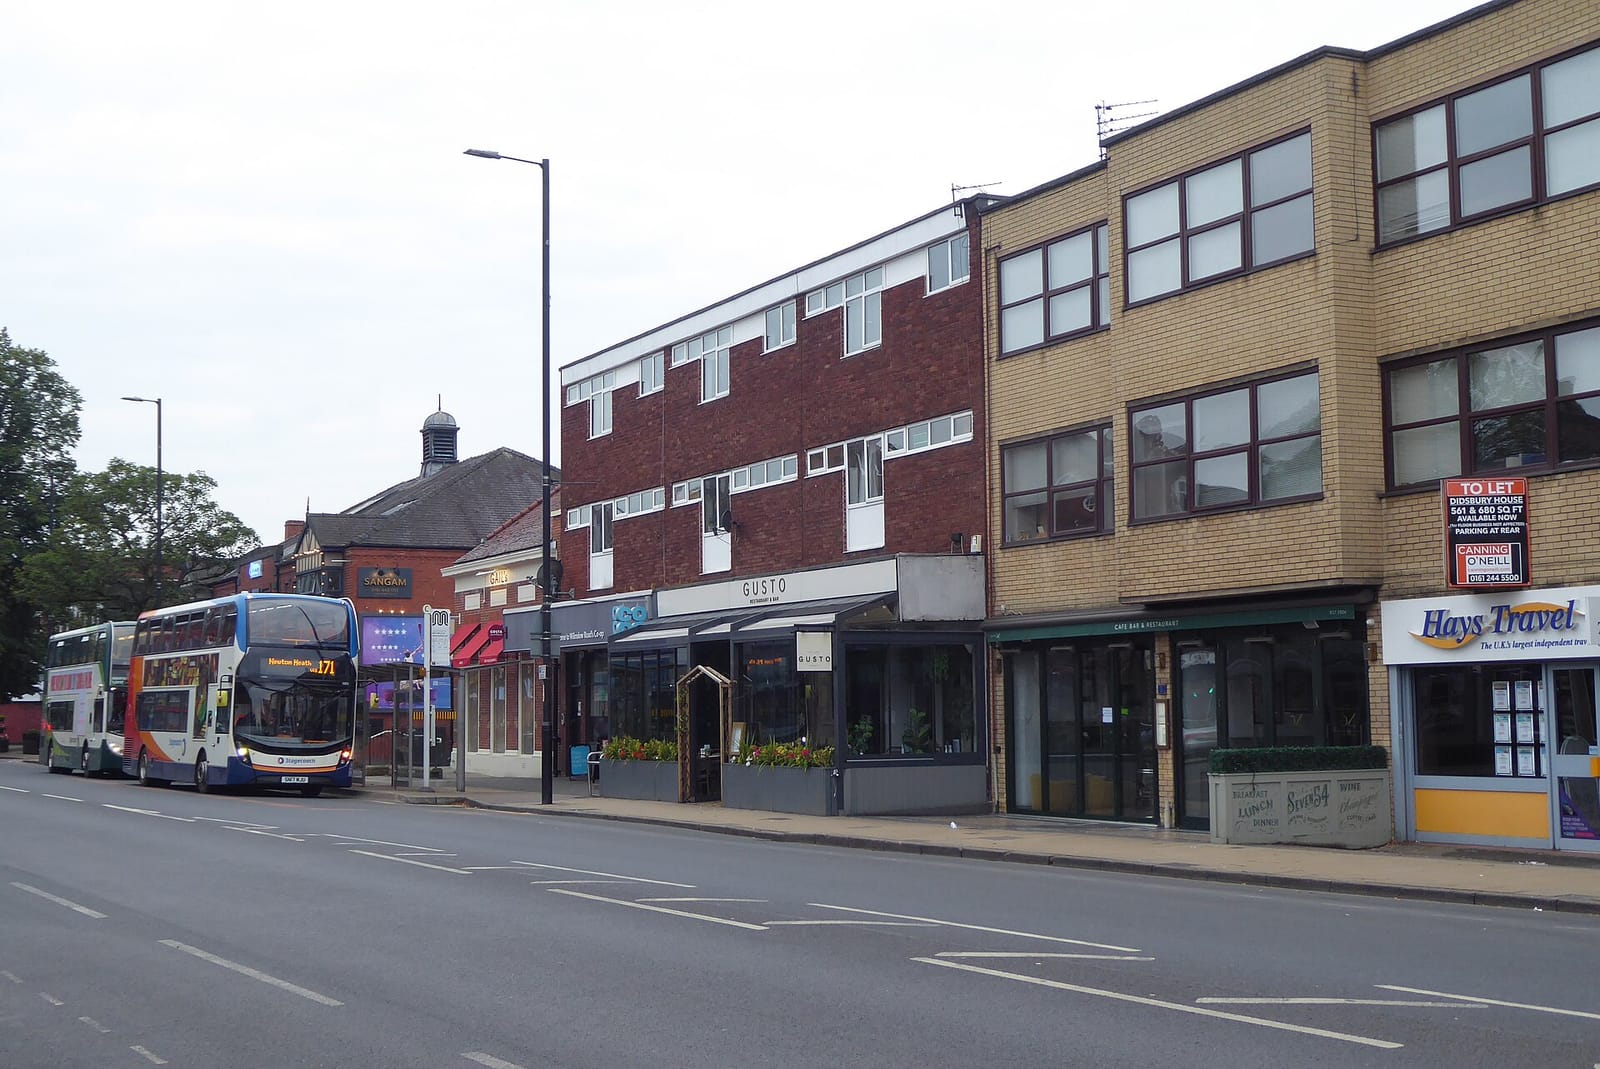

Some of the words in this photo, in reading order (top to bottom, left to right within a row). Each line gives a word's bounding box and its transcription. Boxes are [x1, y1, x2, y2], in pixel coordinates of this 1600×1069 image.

[1460, 482, 1483, 495] TO
[1487, 481, 1514, 494] LET
[1450, 497, 1492, 505] DIDSBURY
[1494, 496, 1523, 504] HOUSE
[1451, 506, 1466, 515] 561
[1469, 506, 1476, 514] &
[1478, 506, 1495, 514] 680
[1497, 505, 1510, 514] SQ
[1512, 505, 1523, 513] FT
[1457, 514, 1496, 522] AVAILABLE
[1455, 527, 1488, 535] PARKING
[1458, 545, 1508, 555] CANNING
[1467, 556, 1510, 566] O'NEILL
[364, 577, 407, 586] SANGAM
[1470, 574, 1485, 582] 0161
[1486, 574, 1500, 582] 244
[743, 578, 786, 597] GUSTO
[1146, 619, 1179, 628] RESTAURANT
[1421, 608, 1484, 643] Hays
[1490, 599, 1576, 634] Travel
[1481, 642, 1493, 650] The
[1512, 640, 1534, 650] largest
[1534, 638, 1573, 649] independent
[798, 655, 831, 663] GUSTO
[268, 657, 293, 665] Newton
[293, 658, 312, 667] Heath
[318, 660, 335, 675] 171
[285, 757, 316, 765] Stagecoach
[1339, 782, 1361, 792] WINE
[1232, 790, 1268, 799] BREAKFAST
[1238, 799, 1273, 818] LUNCH
[1253, 818, 1279, 827] DINNER
